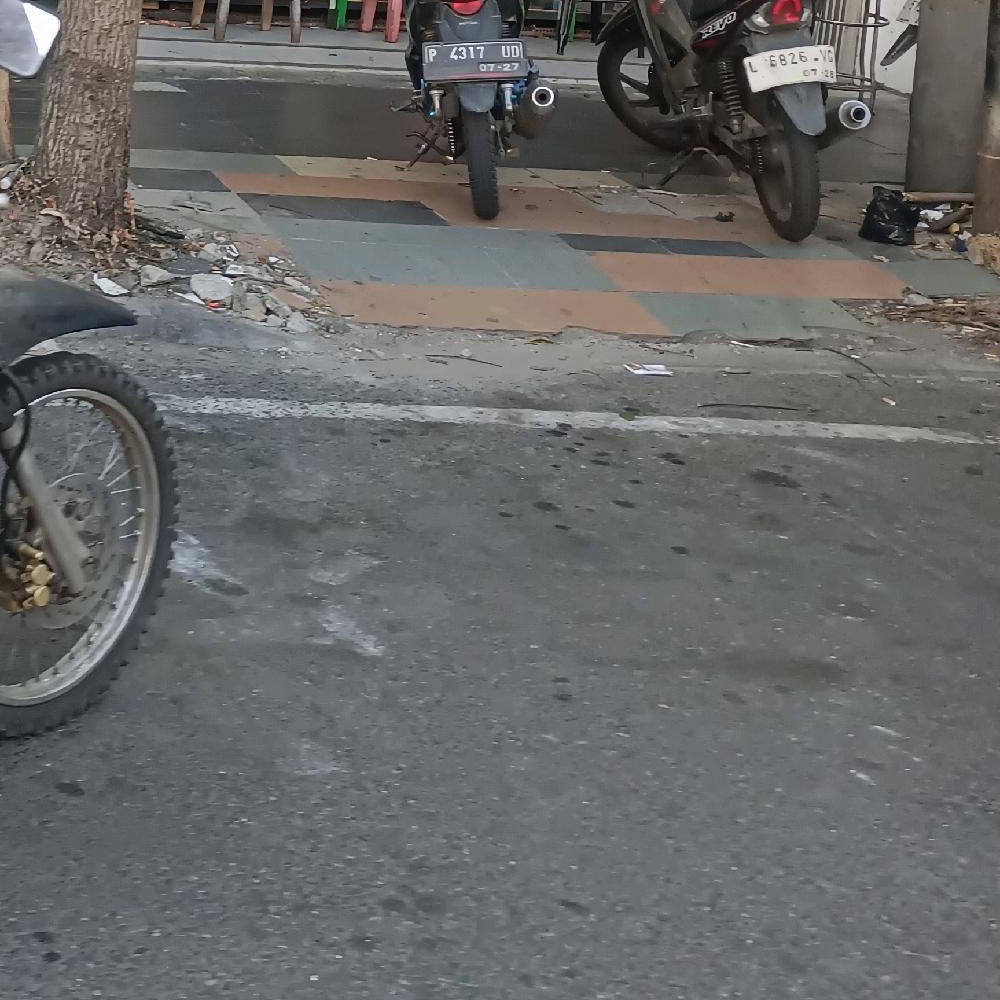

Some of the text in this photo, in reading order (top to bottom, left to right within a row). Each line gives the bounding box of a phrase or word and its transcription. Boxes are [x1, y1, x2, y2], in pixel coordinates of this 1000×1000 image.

[428, 48, 437, 62] P
[450, 46, 485, 60] 4317
[748, 61, 758, 73] L
